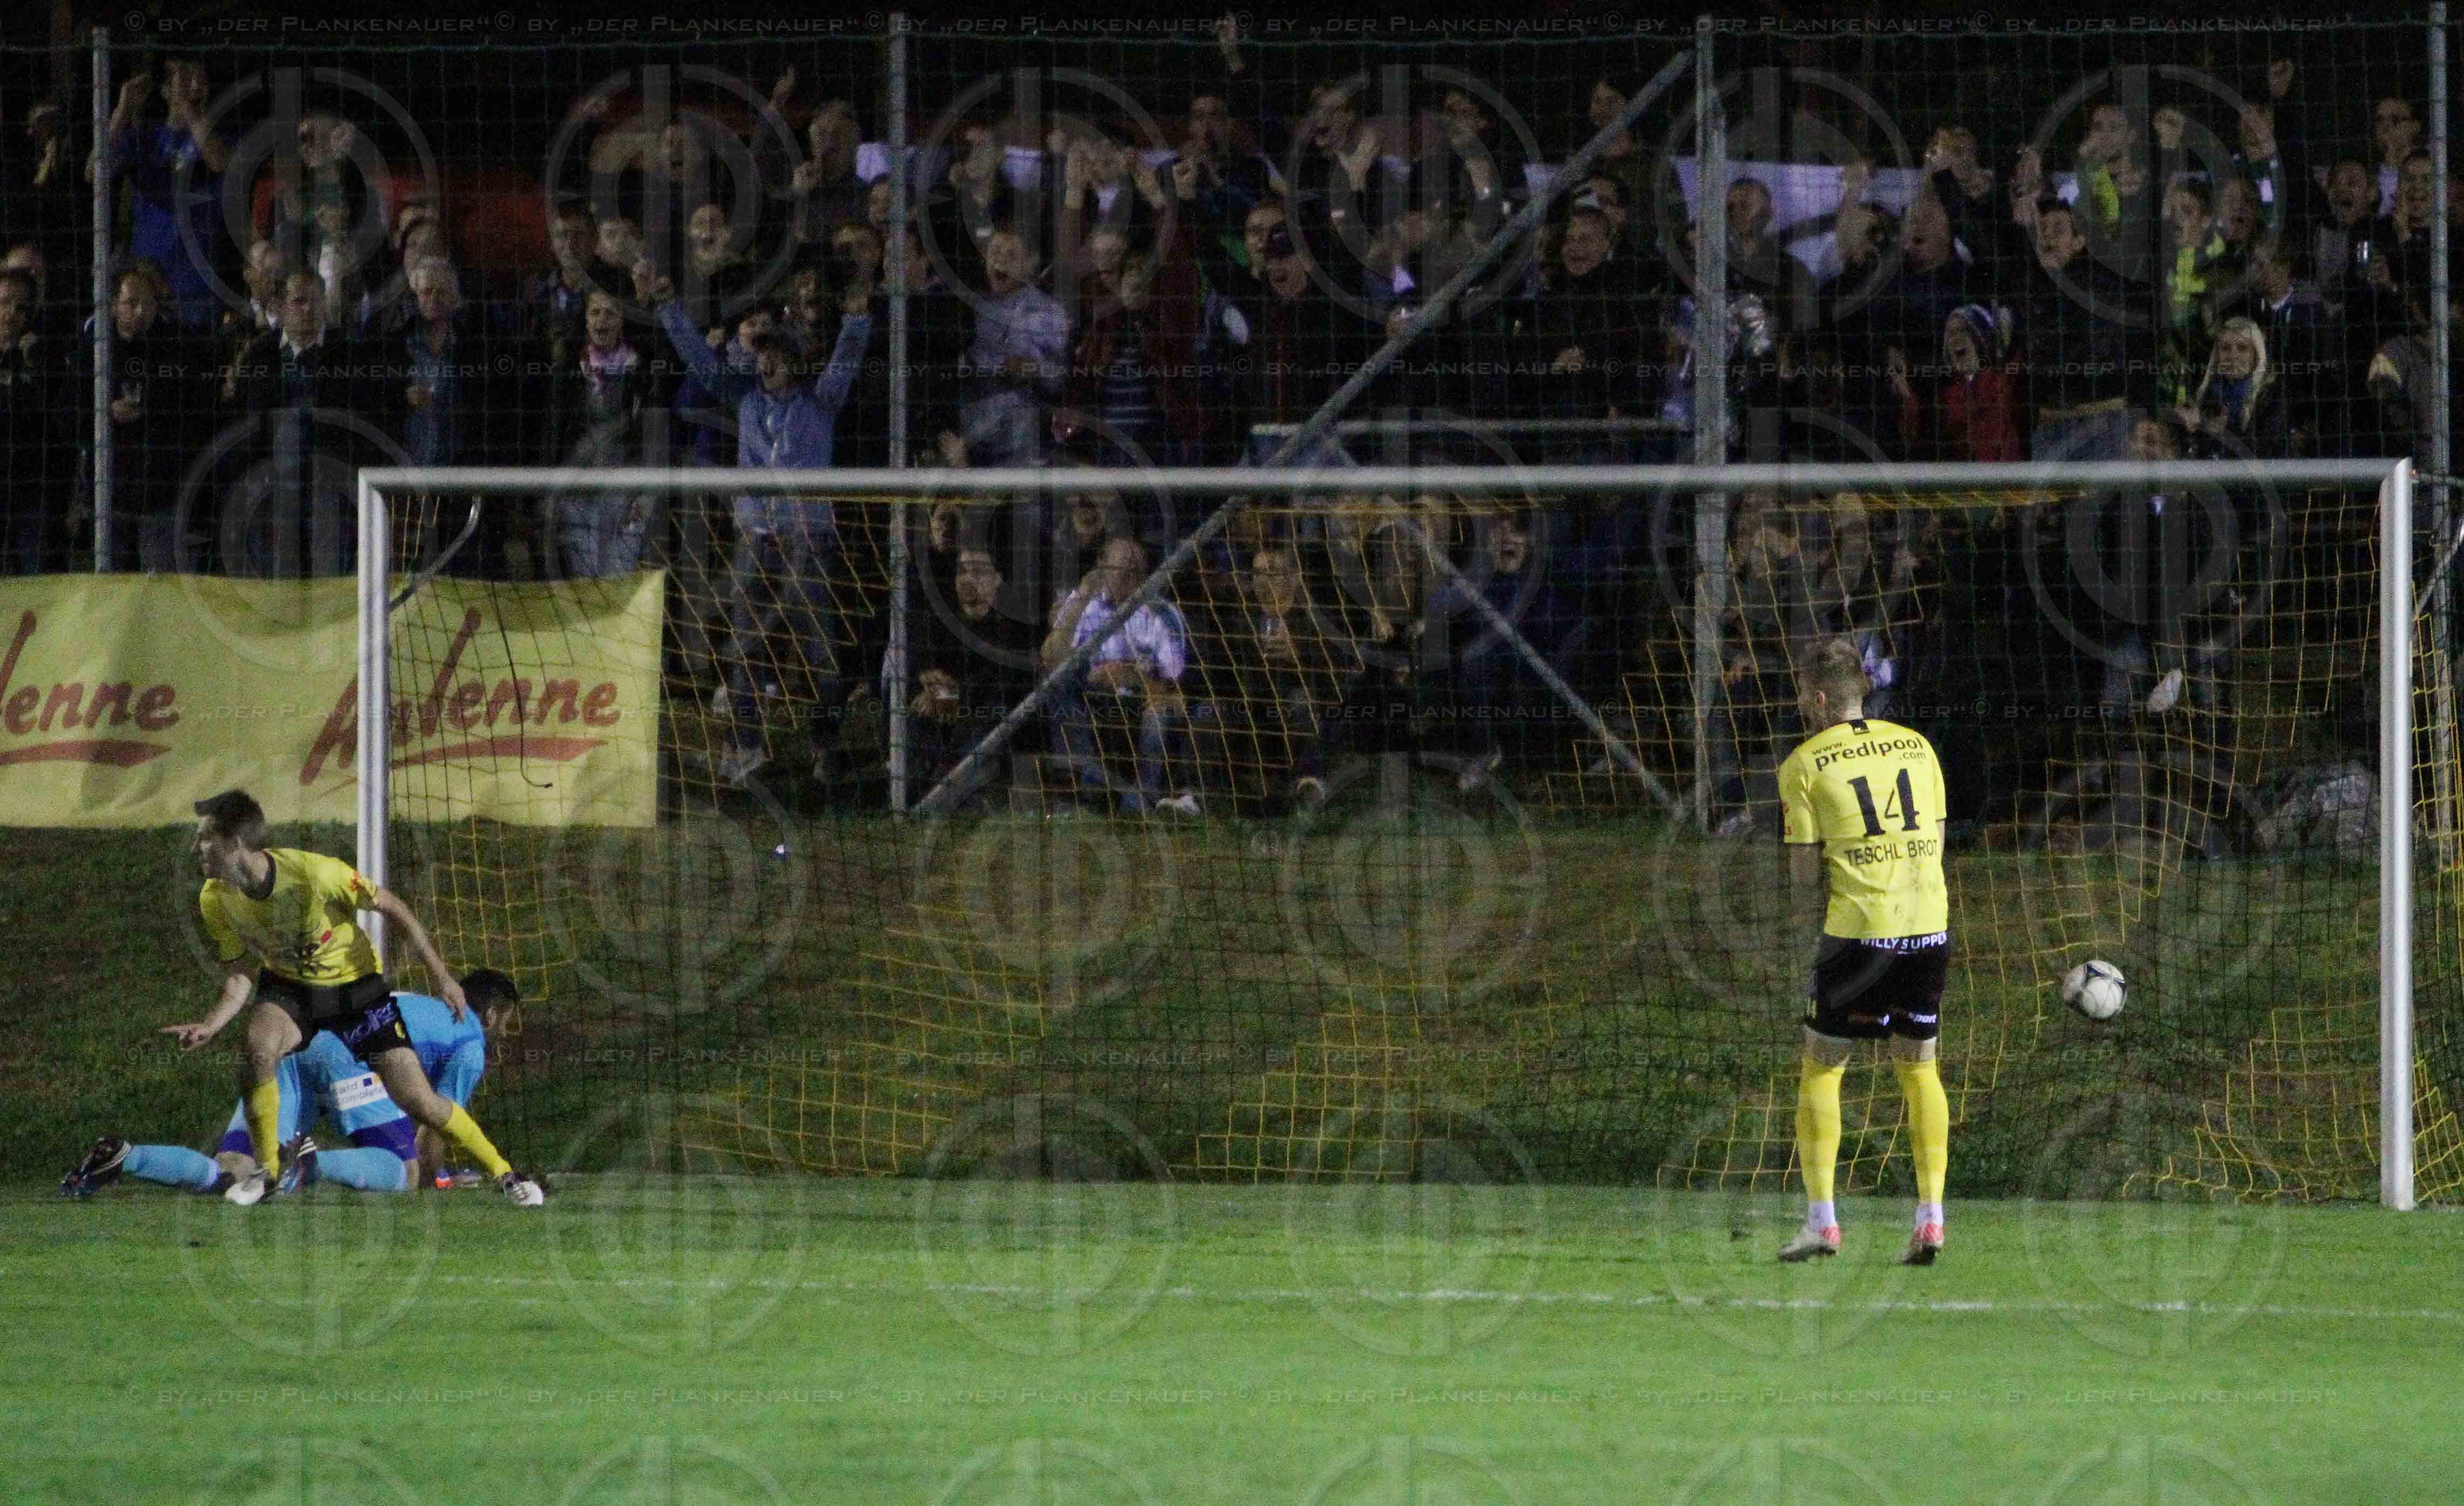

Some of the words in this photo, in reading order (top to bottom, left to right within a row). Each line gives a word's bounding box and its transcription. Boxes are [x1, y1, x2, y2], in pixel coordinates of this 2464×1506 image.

[1847, 768, 1921, 838] 14
[1844, 842, 1903, 866] TESCHL
[1907, 838, 1938, 858] BROT
